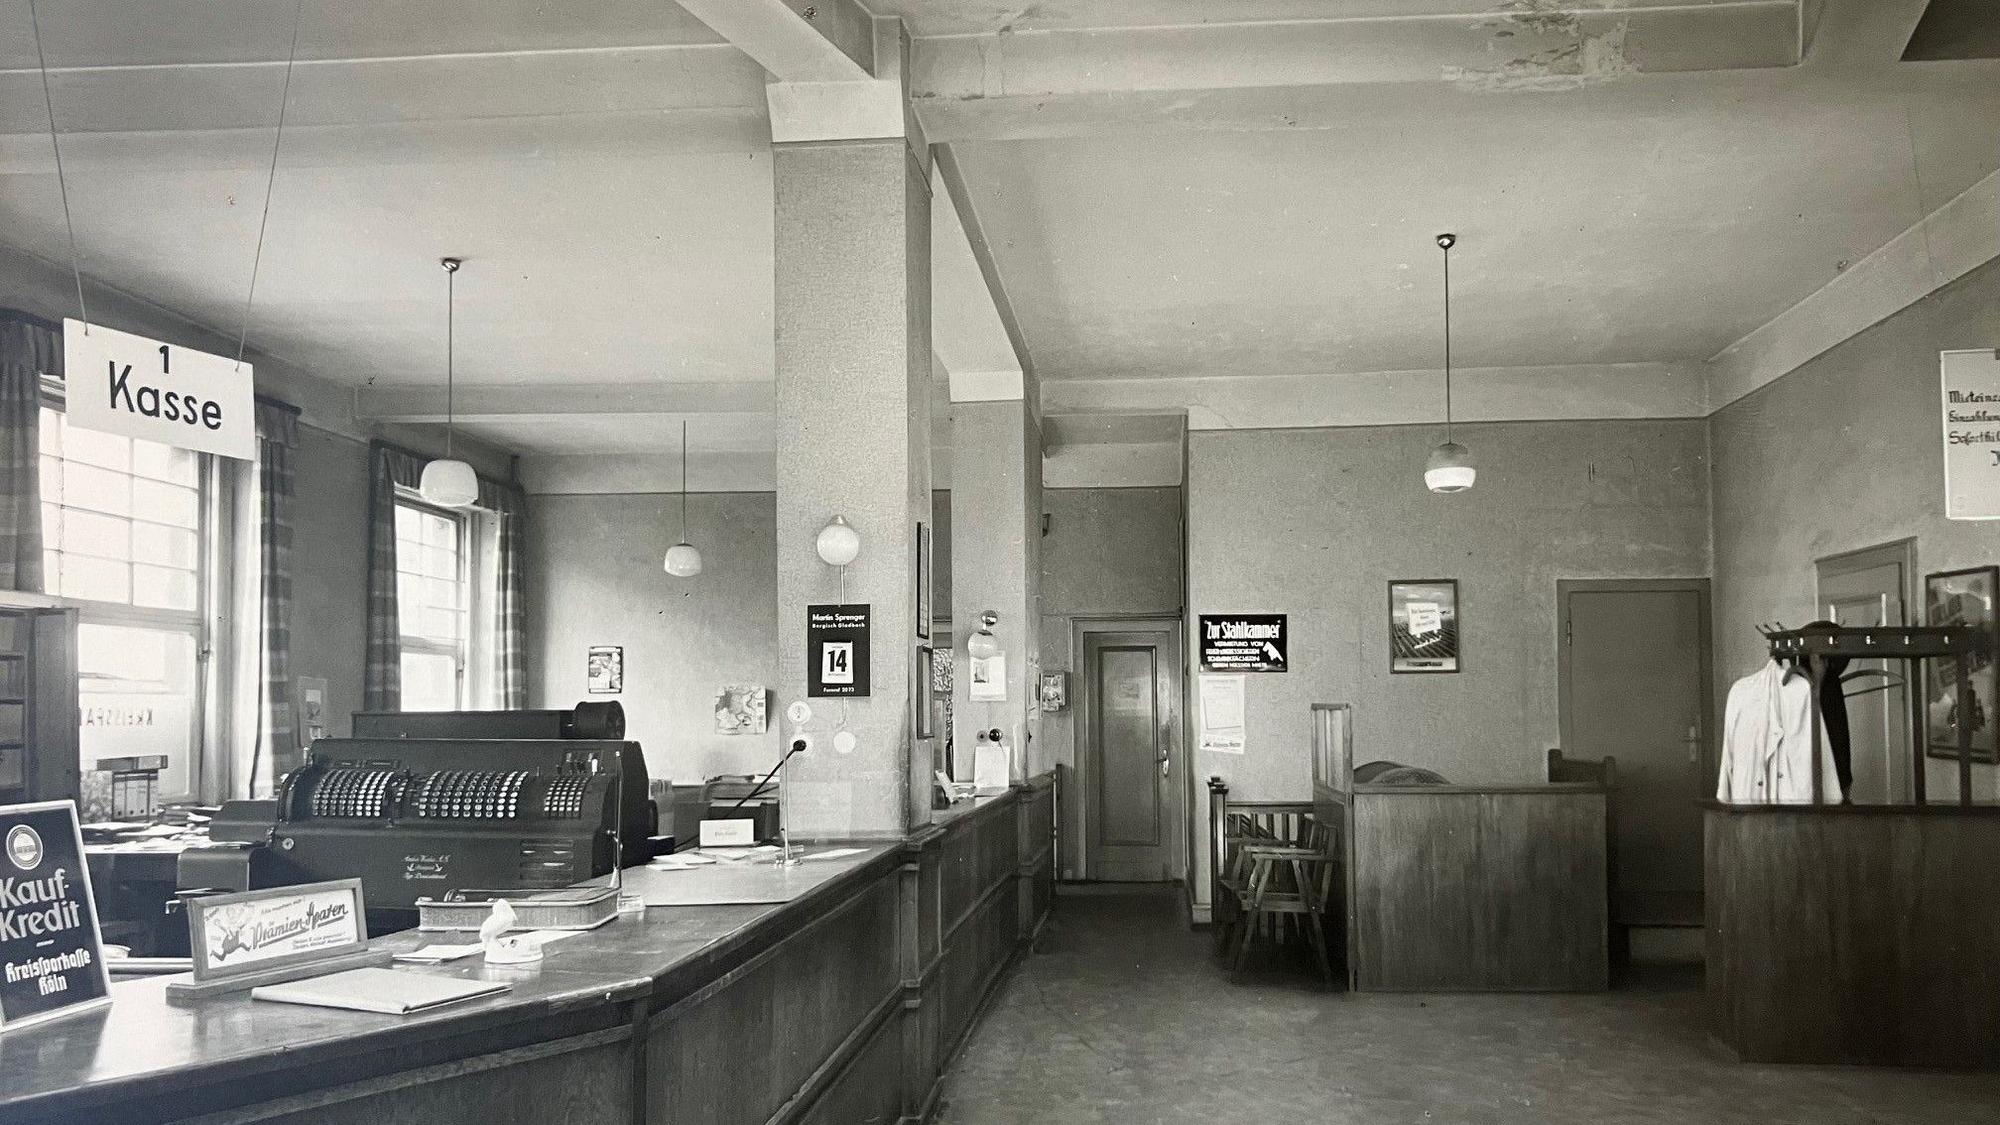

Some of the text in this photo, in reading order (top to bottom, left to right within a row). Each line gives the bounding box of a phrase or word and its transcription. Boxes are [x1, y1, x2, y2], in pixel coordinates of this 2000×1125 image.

[159, 345, 169, 374] 1
[109, 360, 222, 430] Kasse
[812, 613, 866, 622] Martin Sprenger
[1206, 621, 1280, 639] Zur Stahlkammer
[827, 649, 847, 672] 14
[0, 900, 80, 941] Kredit
[5, 948, 92, 983] Kreissparkasse
[38, 974, 68, 996] Köln
